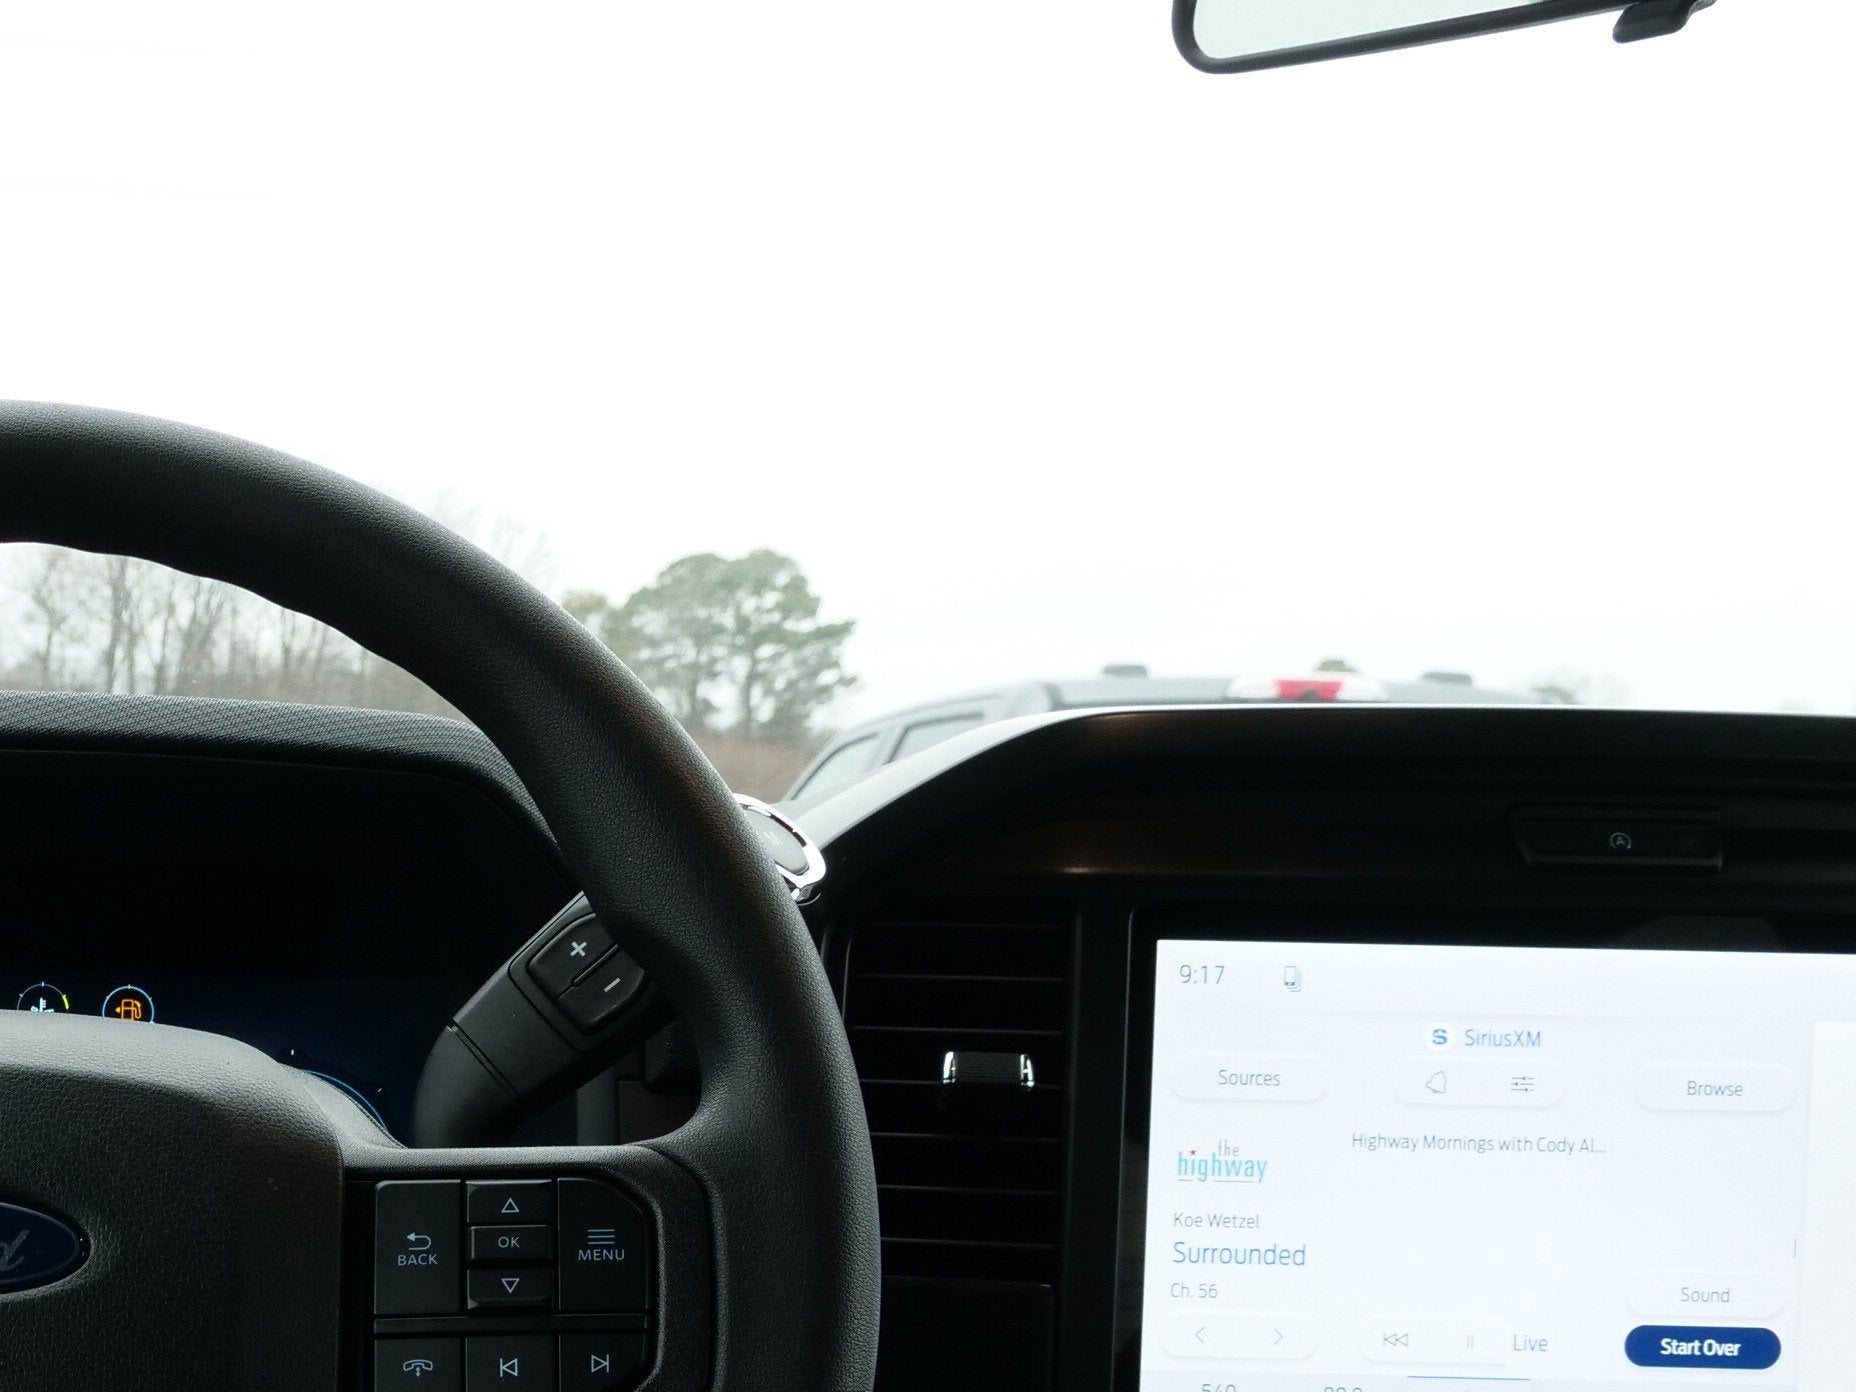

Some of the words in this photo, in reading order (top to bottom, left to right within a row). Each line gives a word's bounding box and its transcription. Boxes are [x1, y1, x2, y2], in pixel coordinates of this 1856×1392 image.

[1179, 965, 1225, 984] 9:17
[1464, 1028, 1541, 1048] SiriusXM
[1218, 1069, 1281, 1086] Sources
[1686, 1080, 1743, 1097] Browse
[1218, 1139, 1239, 1157] the
[1351, 1133, 1418, 1152] Highway
[1422, 1134, 1494, 1153] Mornings
[1499, 1136, 1533, 1151] with
[1536, 1137, 1575, 1155] Cody
[1177, 1150, 1268, 1183] highway
[1173, 1212, 1203, 1228] Koe
[1207, 1212, 1260, 1229] Wetzel
[498, 1236, 520, 1248] OK
[397, 1253, 438, 1266] BACK
[577, 1249, 625, 1261] MENU
[1172, 1241, 1307, 1267] Surrounded
[1170, 1283, 1193, 1298] Ch.
[1198, 1284, 1218, 1299] 56
[1681, 1286, 1731, 1303] Sound
[1513, 1334, 1548, 1352] Live
[1660, 1338, 1700, 1355] Start
[1703, 1339, 1740, 1356] Over
